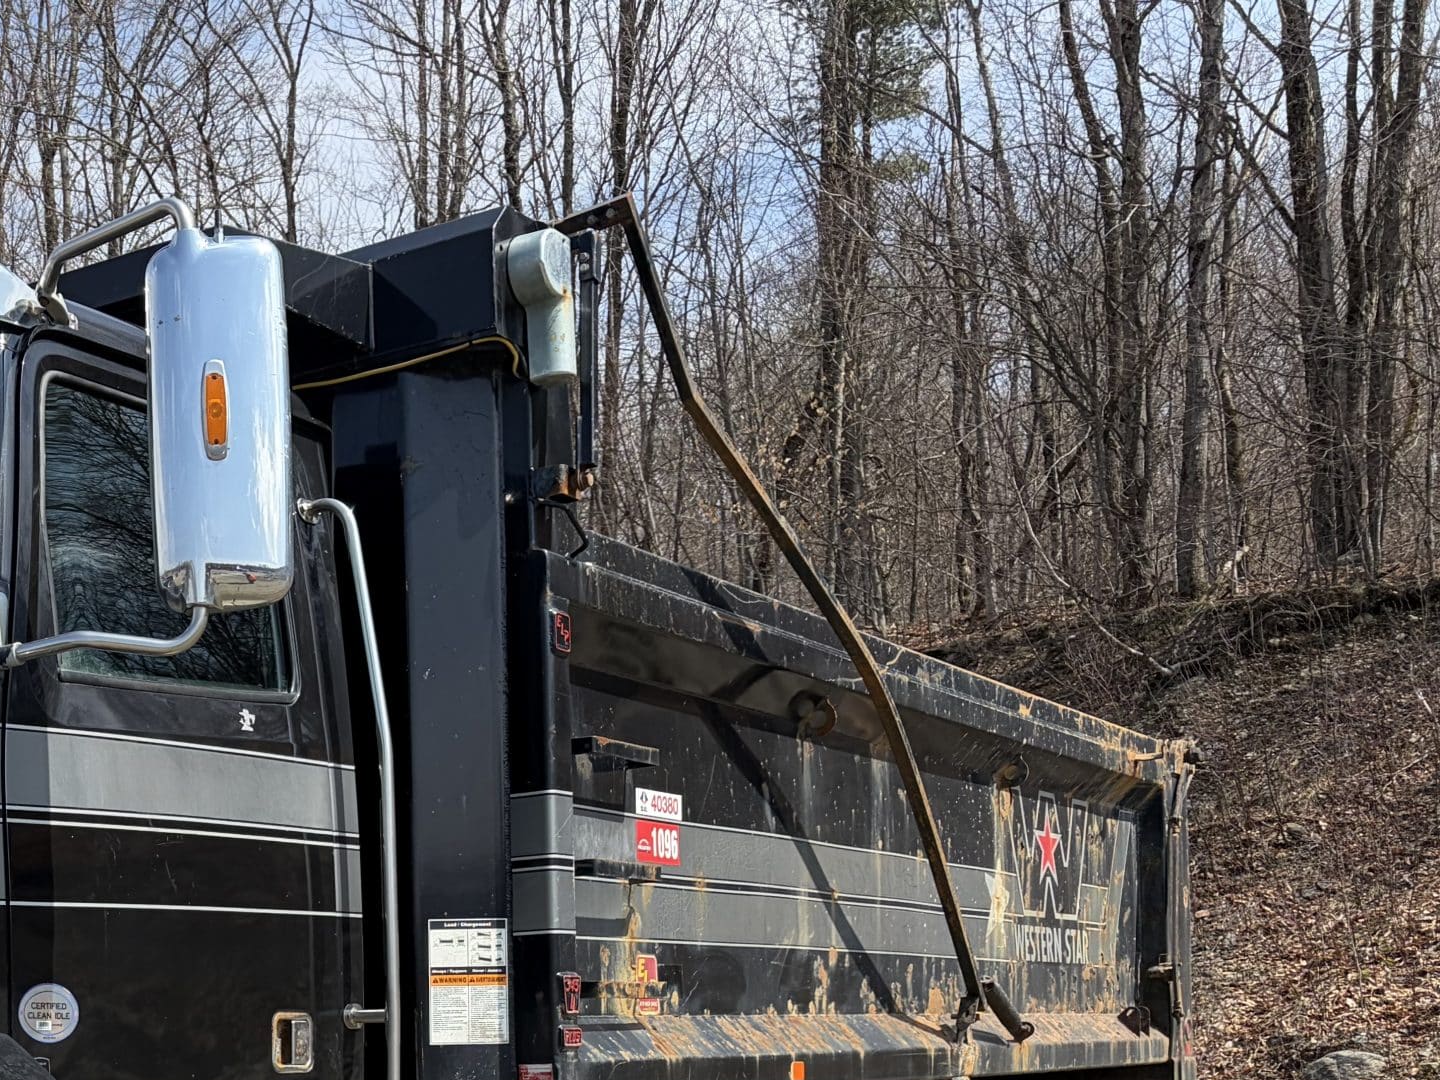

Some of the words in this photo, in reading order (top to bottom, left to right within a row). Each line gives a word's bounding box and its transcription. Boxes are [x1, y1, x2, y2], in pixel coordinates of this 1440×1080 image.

[651, 794, 679, 815] 40380
[651, 826, 679, 860] 1096
[1014, 923, 1063, 963] WESTERN
[1064, 927, 1090, 965] STAR
[439, 976, 467, 984] WARNING
[31, 1001, 67, 1010] CERTIFIED
[27, 1011, 52, 1020] CLEAN
[54, 1011, 70, 1020] IDLE
